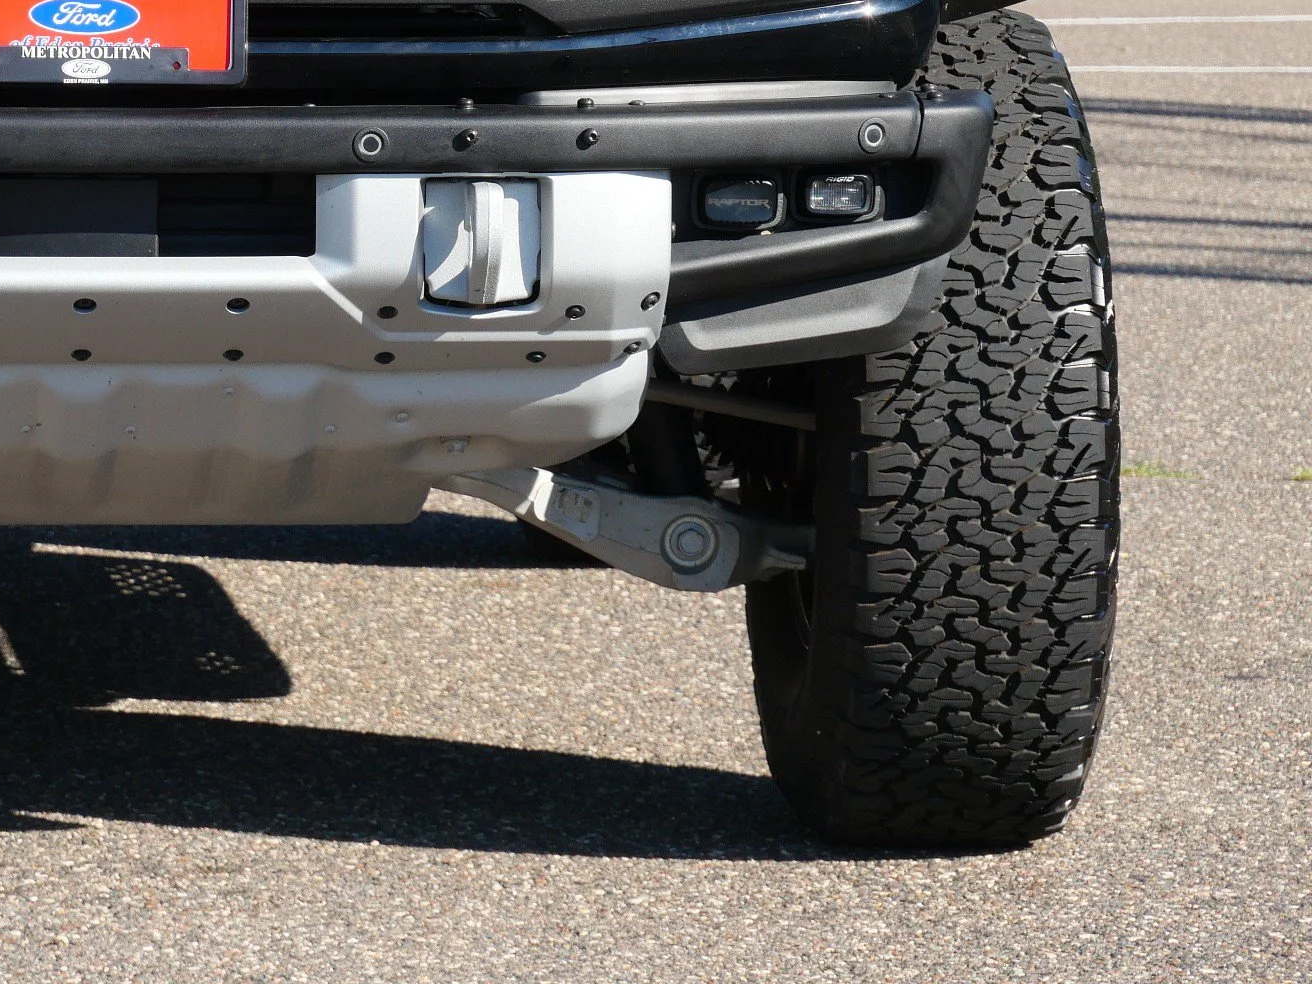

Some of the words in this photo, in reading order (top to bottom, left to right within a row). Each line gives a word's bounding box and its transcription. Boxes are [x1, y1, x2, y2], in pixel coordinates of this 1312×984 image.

[52, 1, 117, 27] Ford
[21, 45, 151, 60] METROPOLITAN
[708, 198, 770, 209] RAPTOR
